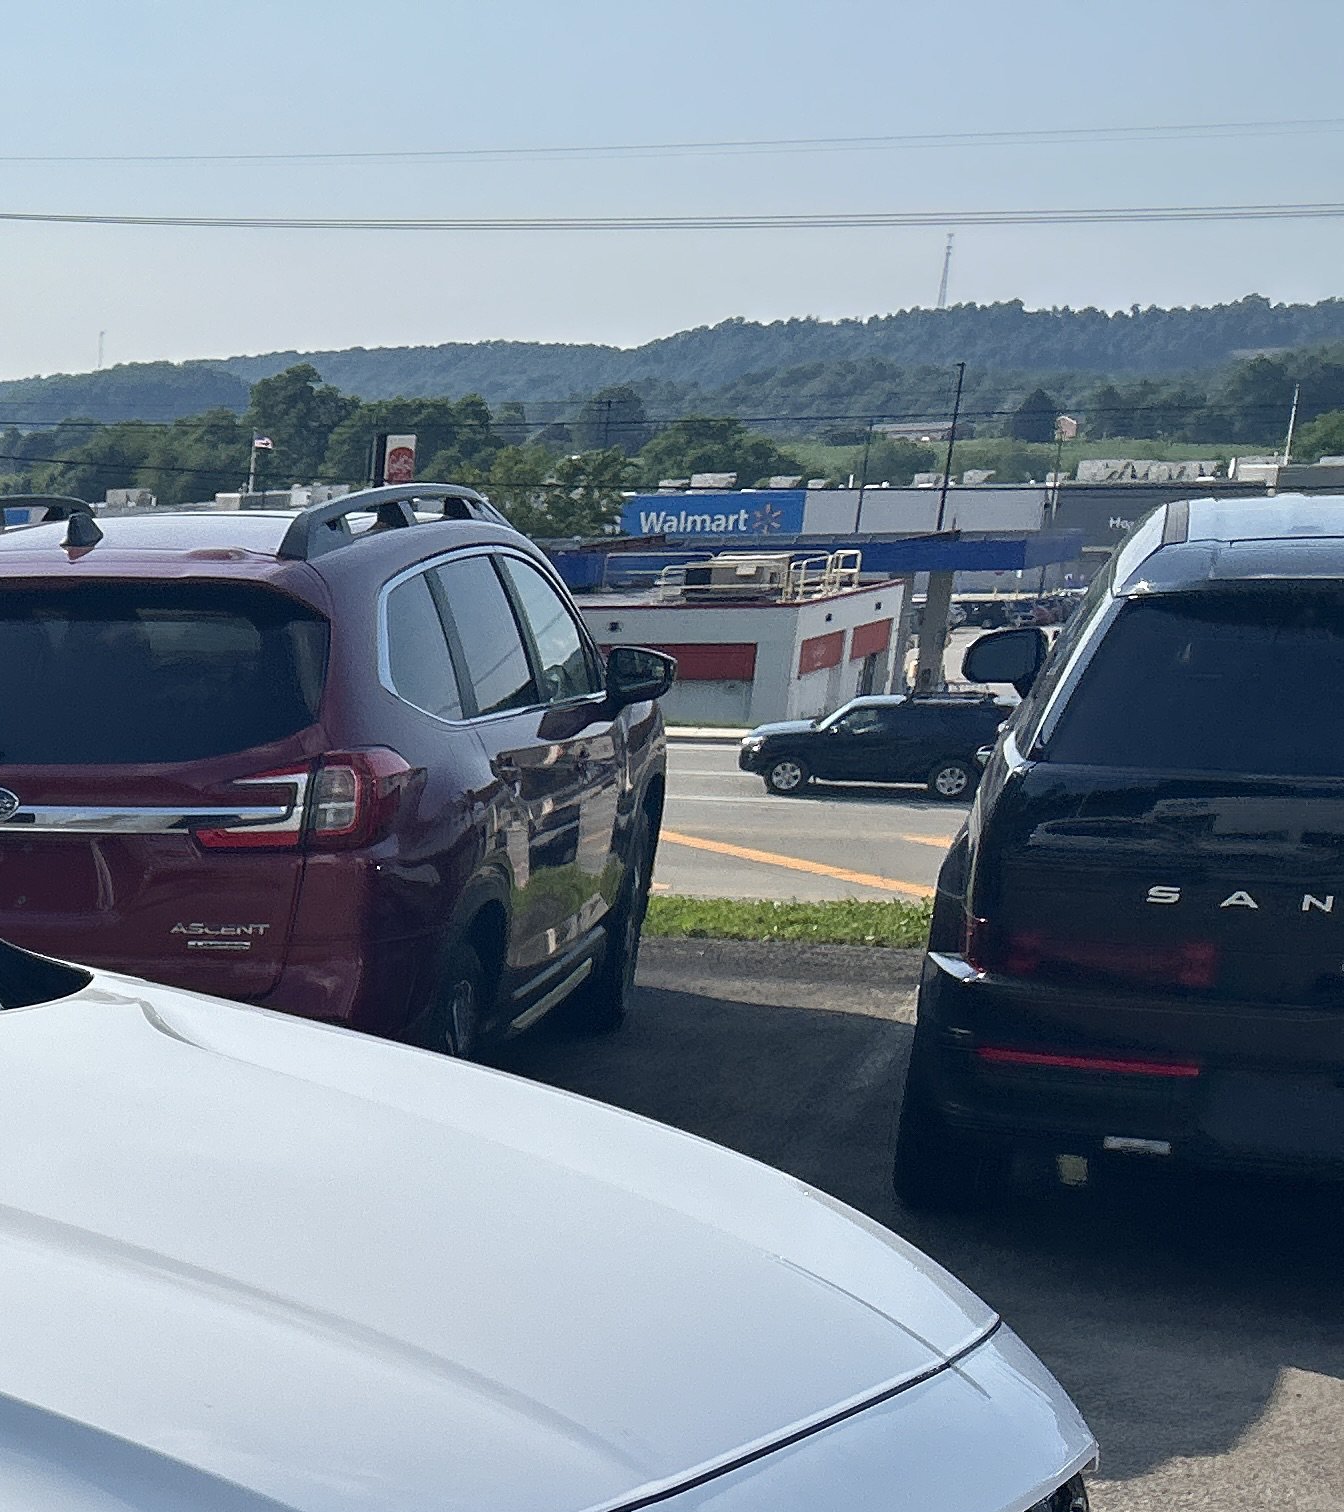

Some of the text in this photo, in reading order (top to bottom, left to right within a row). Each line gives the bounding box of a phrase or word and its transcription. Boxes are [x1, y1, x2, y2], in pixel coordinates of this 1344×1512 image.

[639, 509, 749, 534] Walmart
[1146, 885, 1336, 913] SAN
[170, 922, 270, 935] ASCENT
